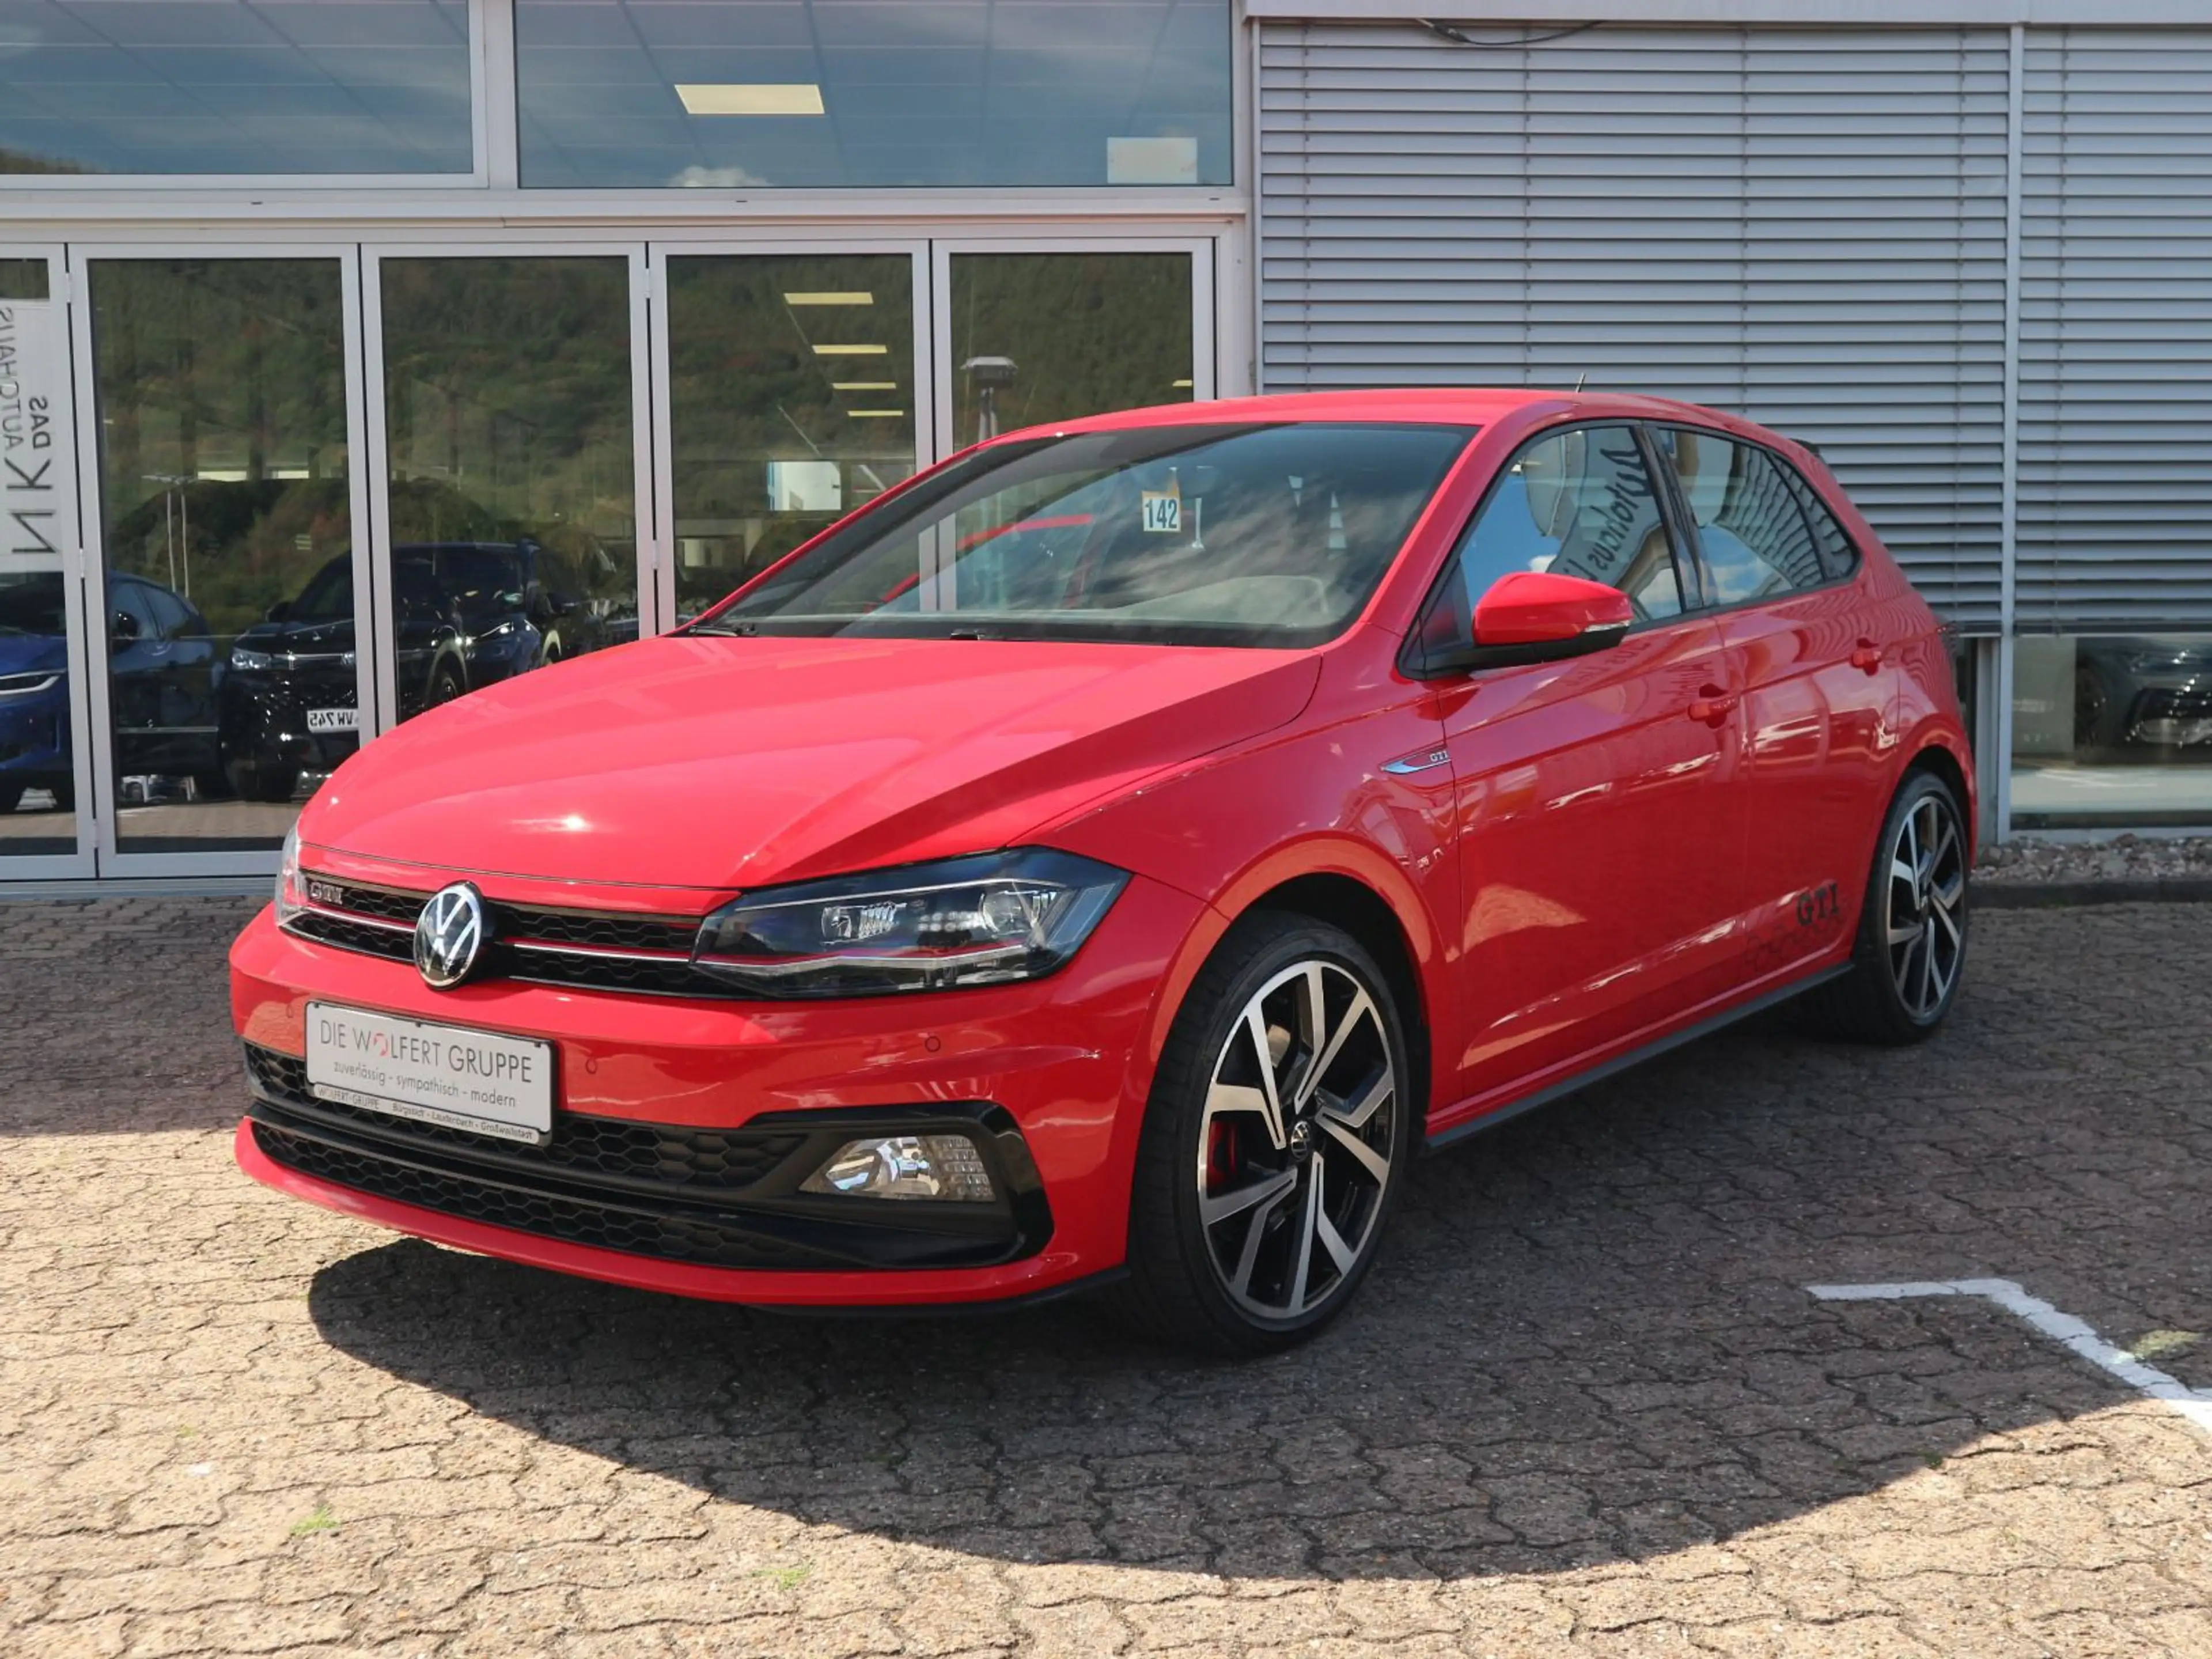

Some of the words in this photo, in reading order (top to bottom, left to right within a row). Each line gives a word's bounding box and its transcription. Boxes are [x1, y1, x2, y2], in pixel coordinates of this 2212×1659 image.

[1145, 499, 1177, 529] 142
[1429, 750, 1449, 763] GTI
[310, 882, 344, 906] GTI
[1796, 882, 1839, 926] GTI
[320, 1020, 347, 1048] DIE
[352, 1027, 441, 1067] WOLFERT
[448, 1044, 532, 1083] GRUPPE
[334, 1061, 385, 1086] zuverlässig
[396, 1073, 459, 1097] sympathisch
[471, 1088, 516, 1107] modern
